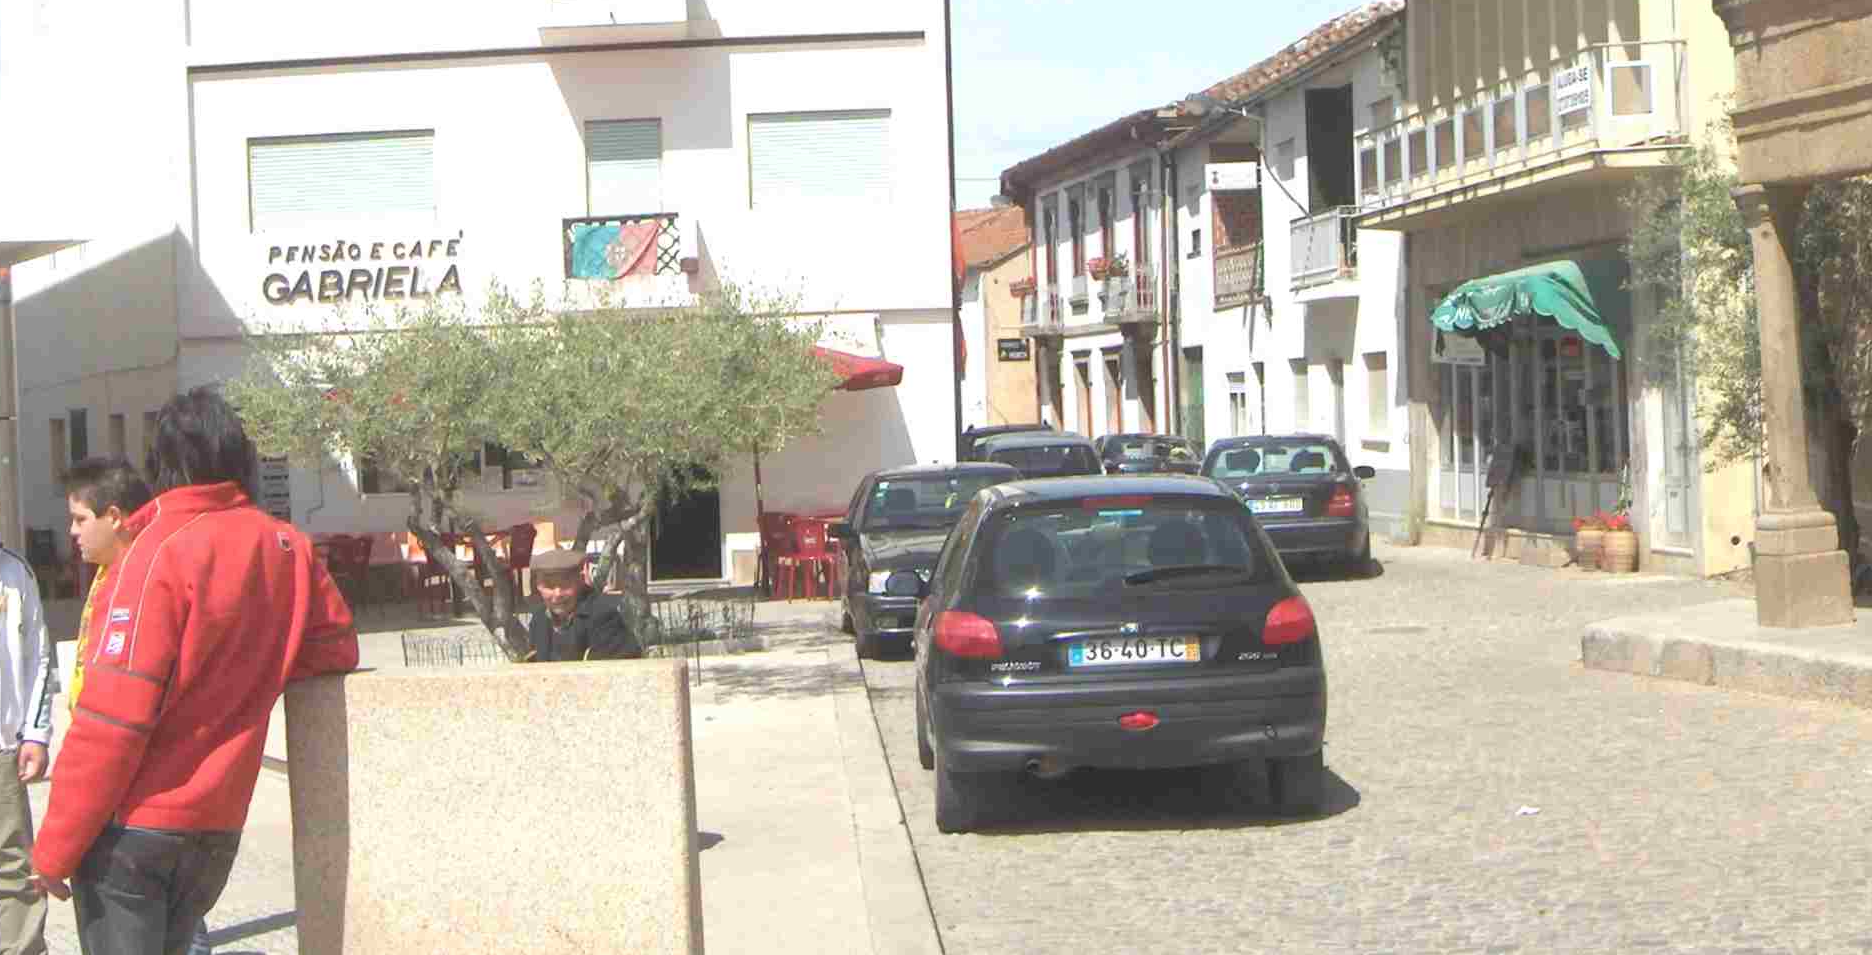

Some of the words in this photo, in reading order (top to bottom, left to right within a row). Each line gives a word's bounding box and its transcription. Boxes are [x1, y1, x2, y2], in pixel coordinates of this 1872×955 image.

[268, 240, 362, 264] PENSÃO
[370, 242, 385, 260] E
[262, 264, 463, 306] GABRIELA
[1085, 637, 1185, 661] 36-40-TC
